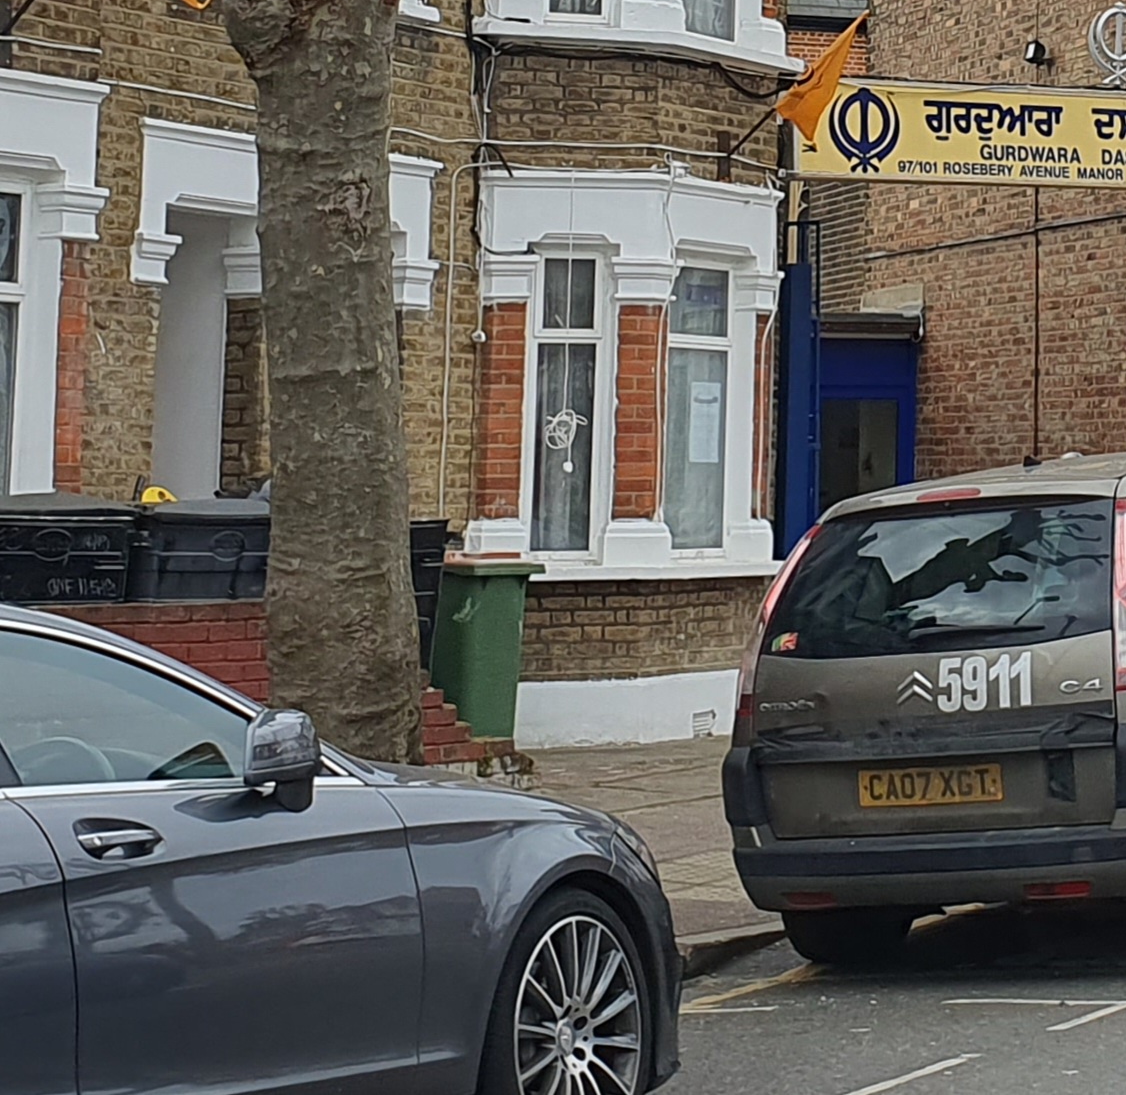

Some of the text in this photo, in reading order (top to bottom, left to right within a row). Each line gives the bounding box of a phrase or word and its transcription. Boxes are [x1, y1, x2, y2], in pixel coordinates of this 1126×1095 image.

[923, 99, 1063, 141] ਗੁਰਦੁਆਰਾ
[979, 144, 1081, 164] GURDWARA
[898, 160, 938, 174] 97/101
[943, 161, 1014, 177] ROSEBERY
[1019, 164, 1070, 179] AVENUE
[1077, 167, 1124, 181] MANOR
[937, 651, 1032, 713] 5911
[1059, 678, 1104, 694] C4
[868, 768, 990, 801] CA07 XGT
